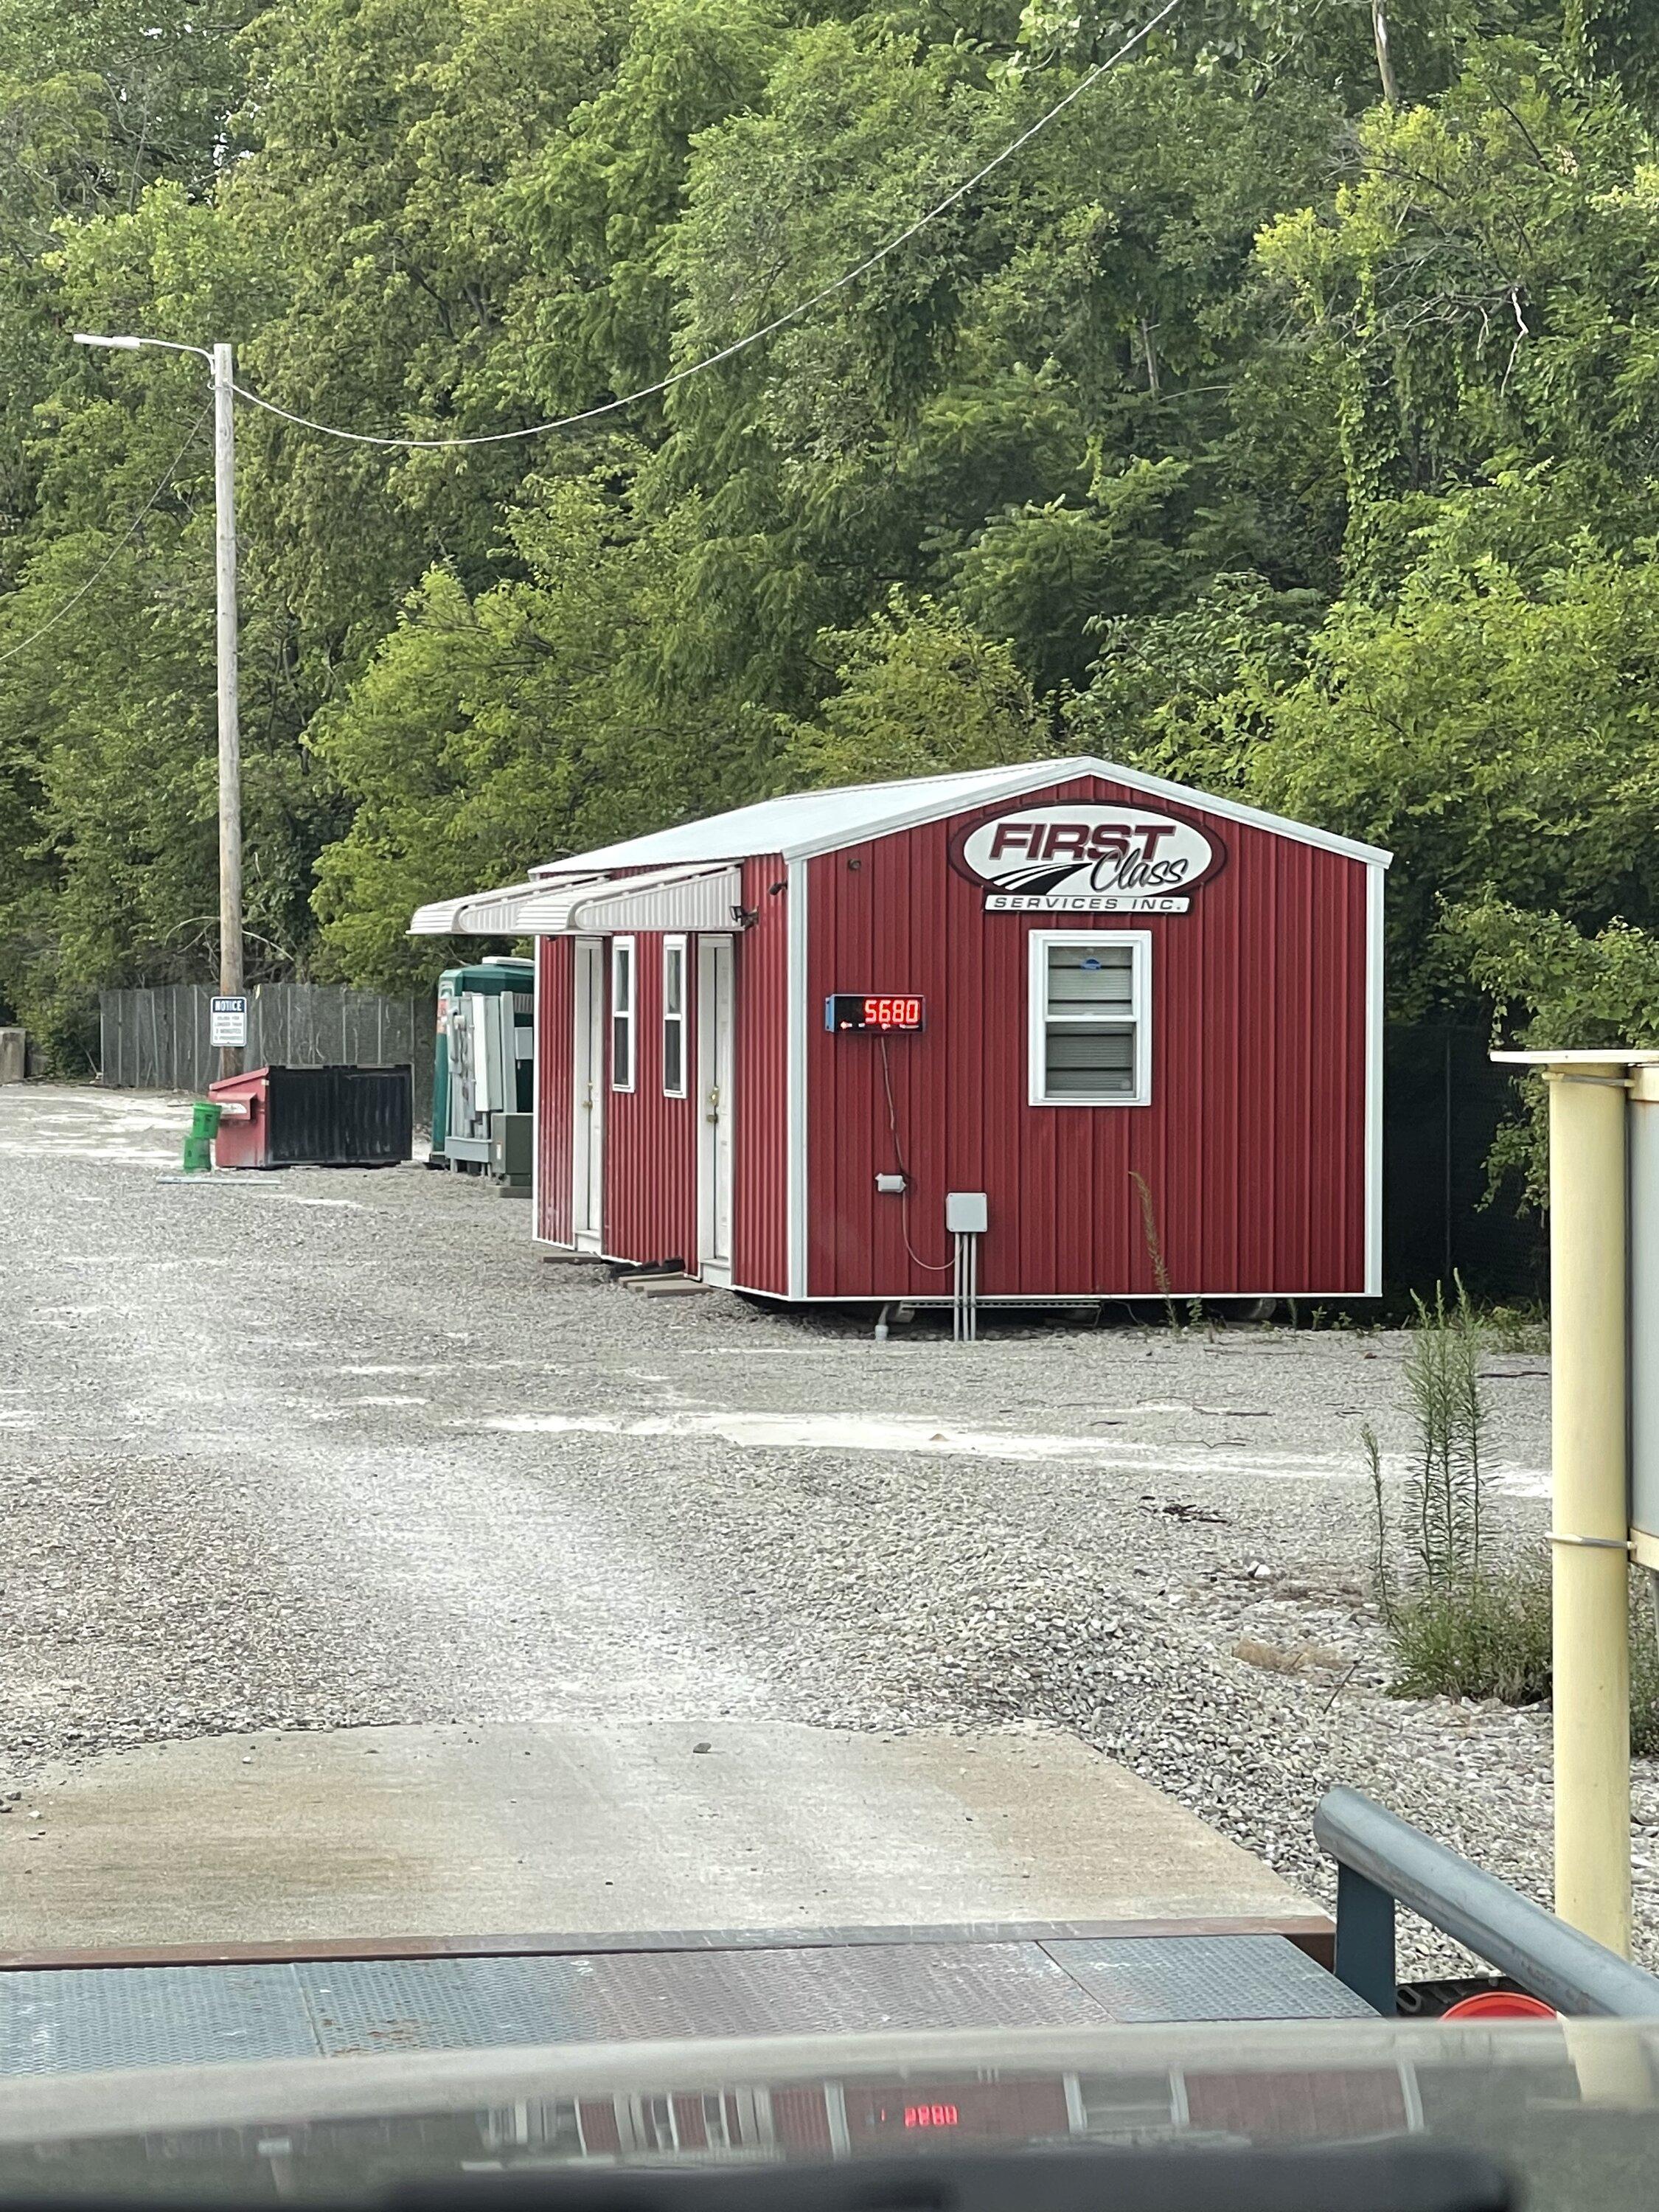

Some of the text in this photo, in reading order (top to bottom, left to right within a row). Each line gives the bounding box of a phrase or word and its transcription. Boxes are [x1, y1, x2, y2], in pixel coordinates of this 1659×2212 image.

[989, 823, 1177, 861] FIRST
[1090, 847, 1189, 893] Class
[993, 897, 1182, 911] SERVICES INC.
[215, 1001, 242, 1011] NOTICE
[865, 1000, 919, 1023] 5680
